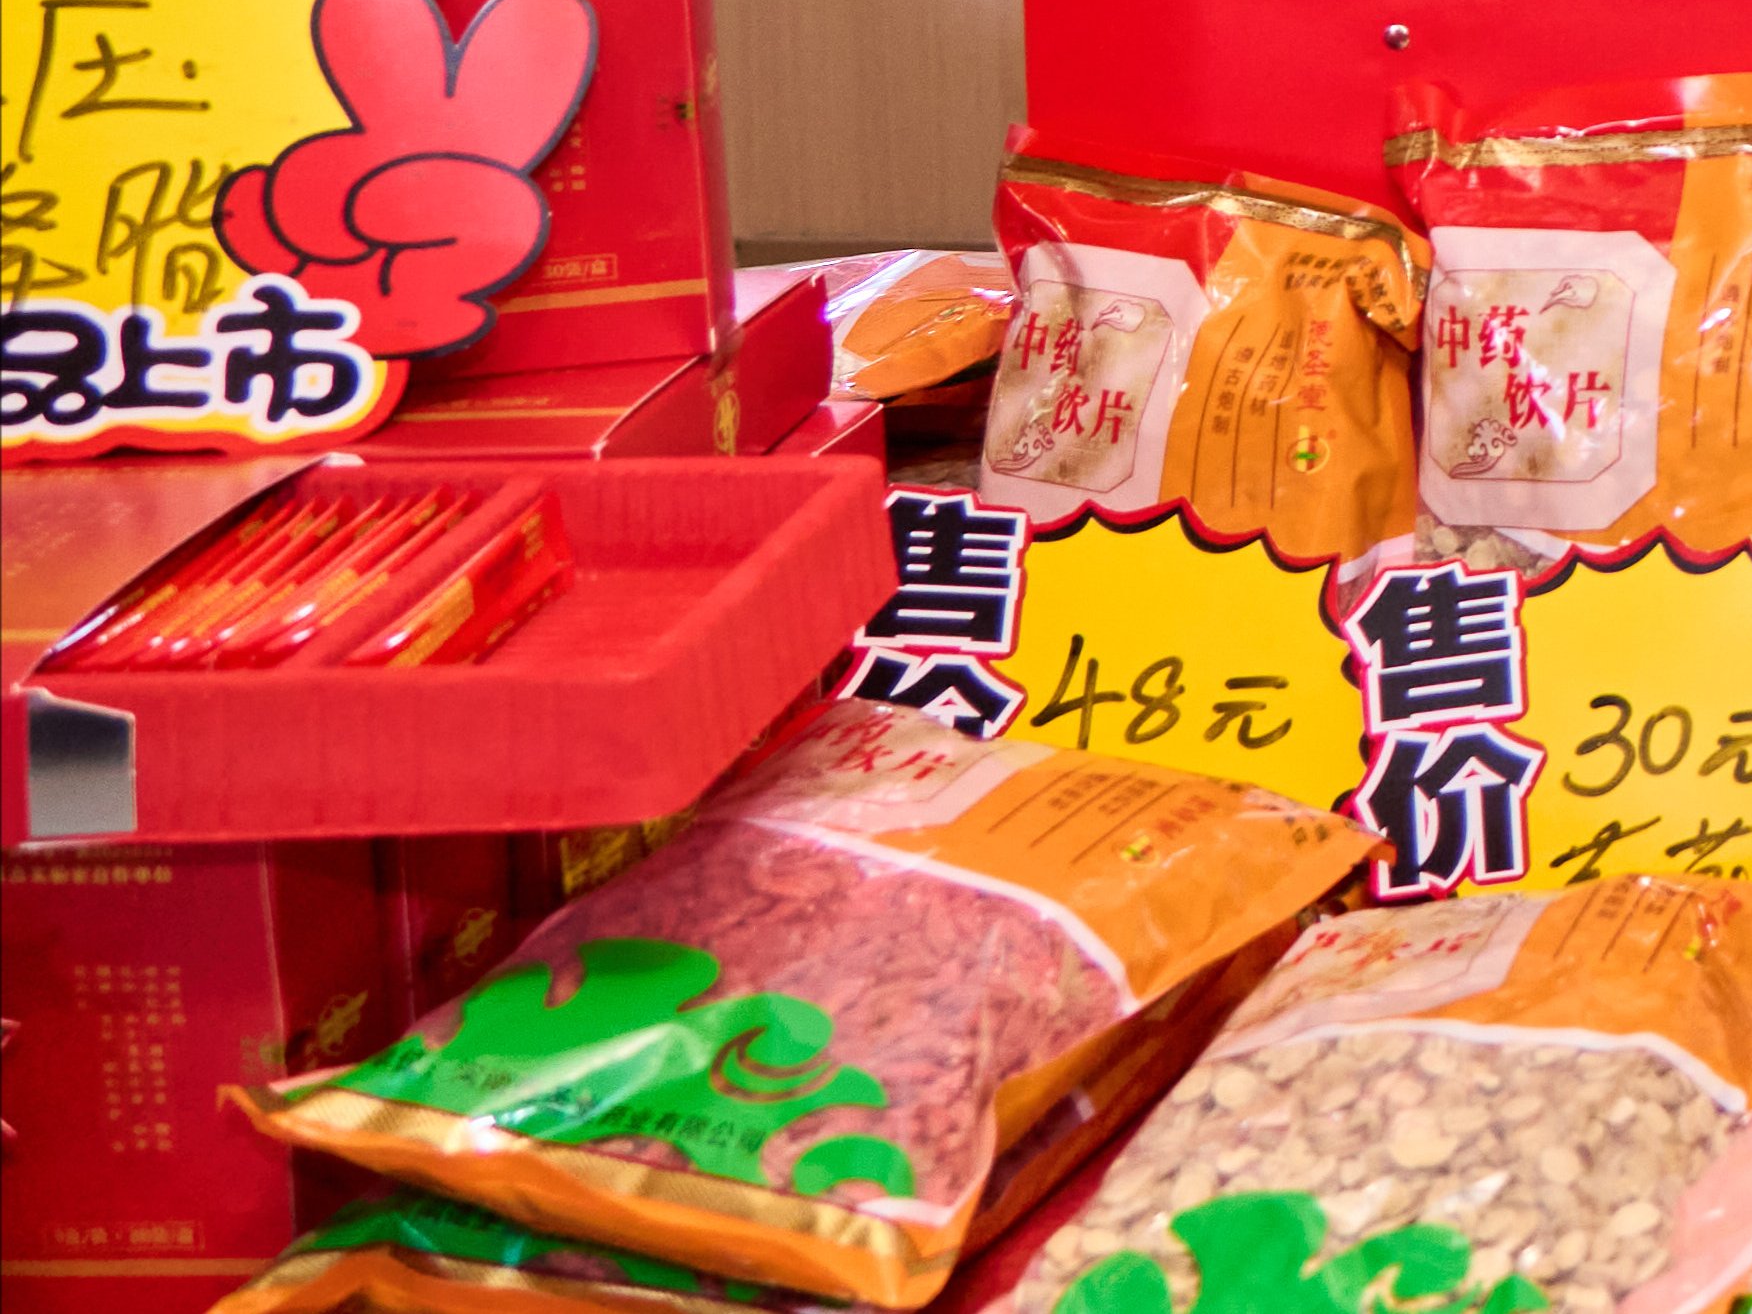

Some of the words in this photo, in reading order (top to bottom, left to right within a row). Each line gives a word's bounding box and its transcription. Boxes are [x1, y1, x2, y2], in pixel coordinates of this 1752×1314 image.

[1011, 311, 1085, 378] 中药
[1436, 303, 1532, 370] 中药
[1050, 381, 1135, 446] 饮片
[1502, 372, 1614, 432] 饮片
[1030, 634, 1294, 752] 48元
[1357, 570, 1537, 890] 售价
